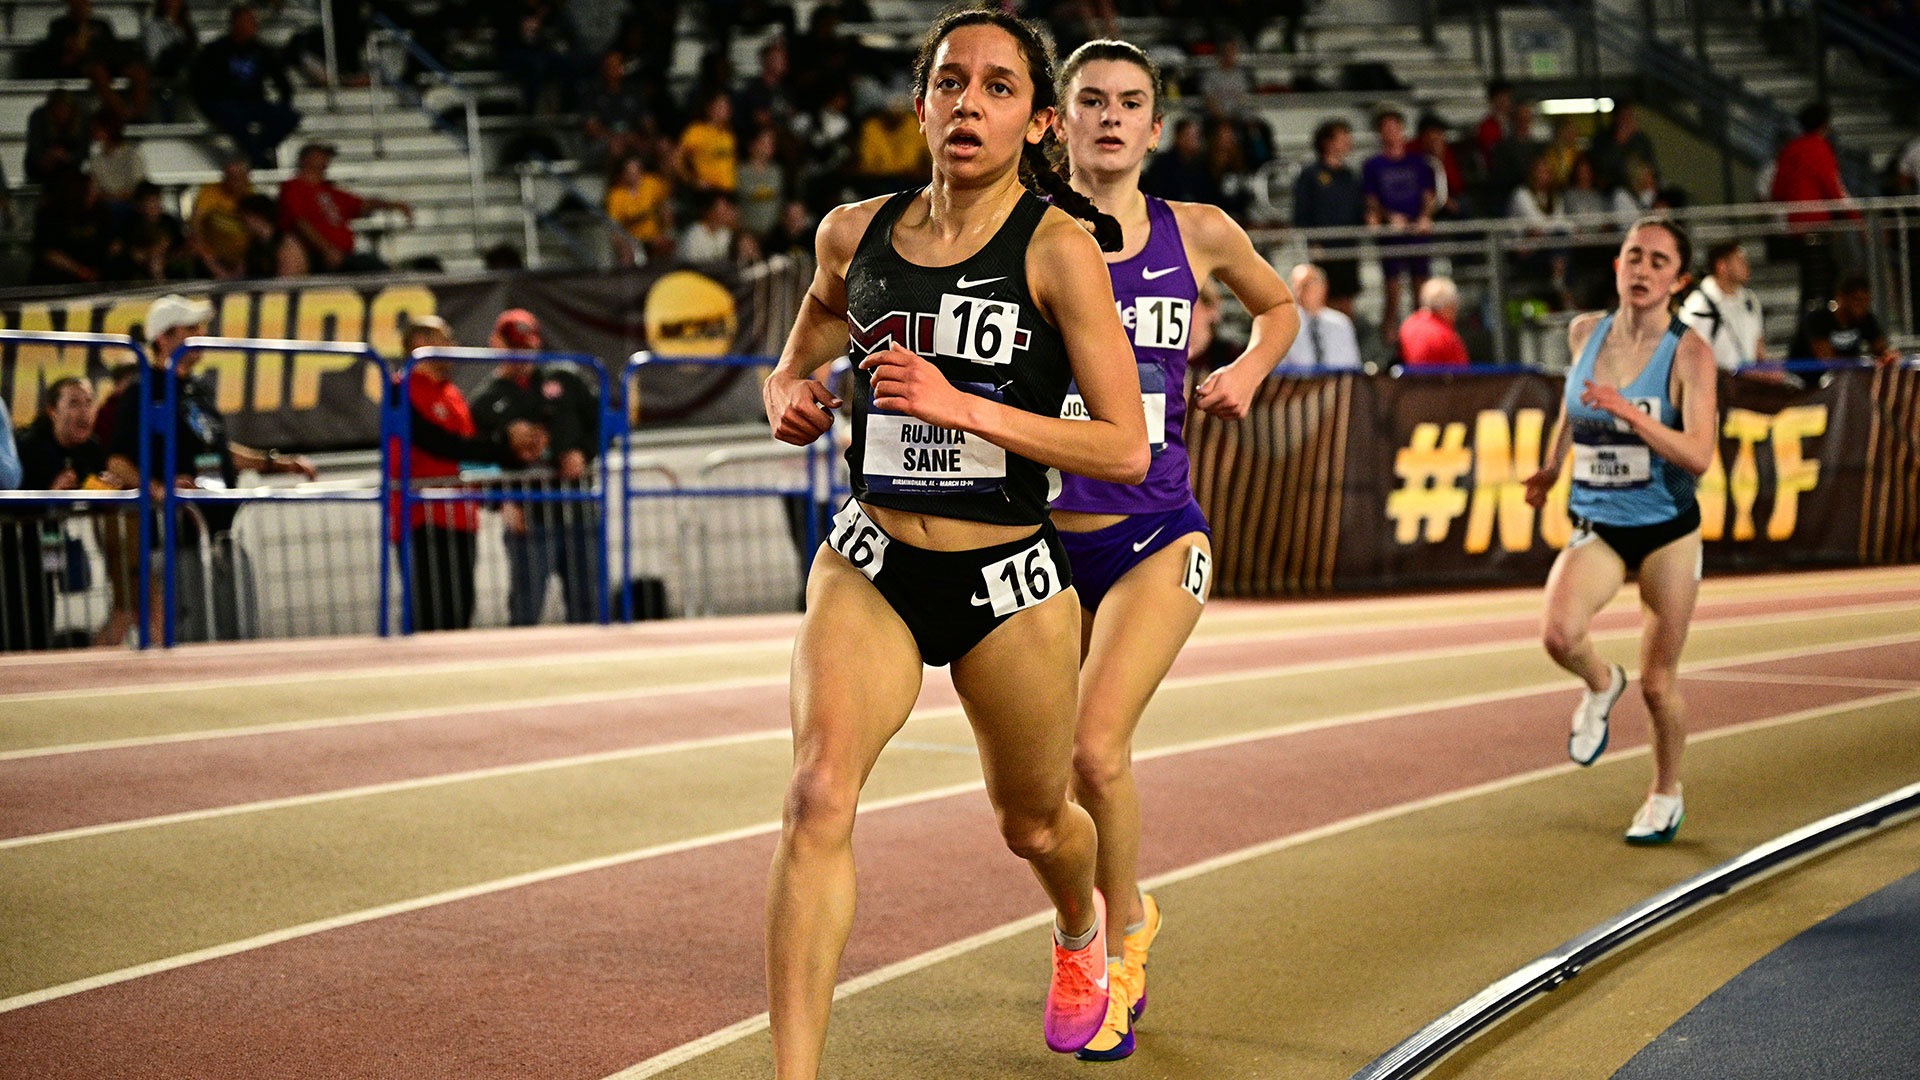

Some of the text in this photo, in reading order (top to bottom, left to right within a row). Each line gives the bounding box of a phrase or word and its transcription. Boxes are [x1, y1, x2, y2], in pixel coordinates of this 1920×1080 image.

[952, 301, 1004, 359] 16
[1149, 301, 1184, 345] 15
[901, 424, 966, 445] RUJUTA
[903, 447, 962, 472] SANE
[838, 511, 879, 569] 16
[999, 549, 1051, 608] 16
